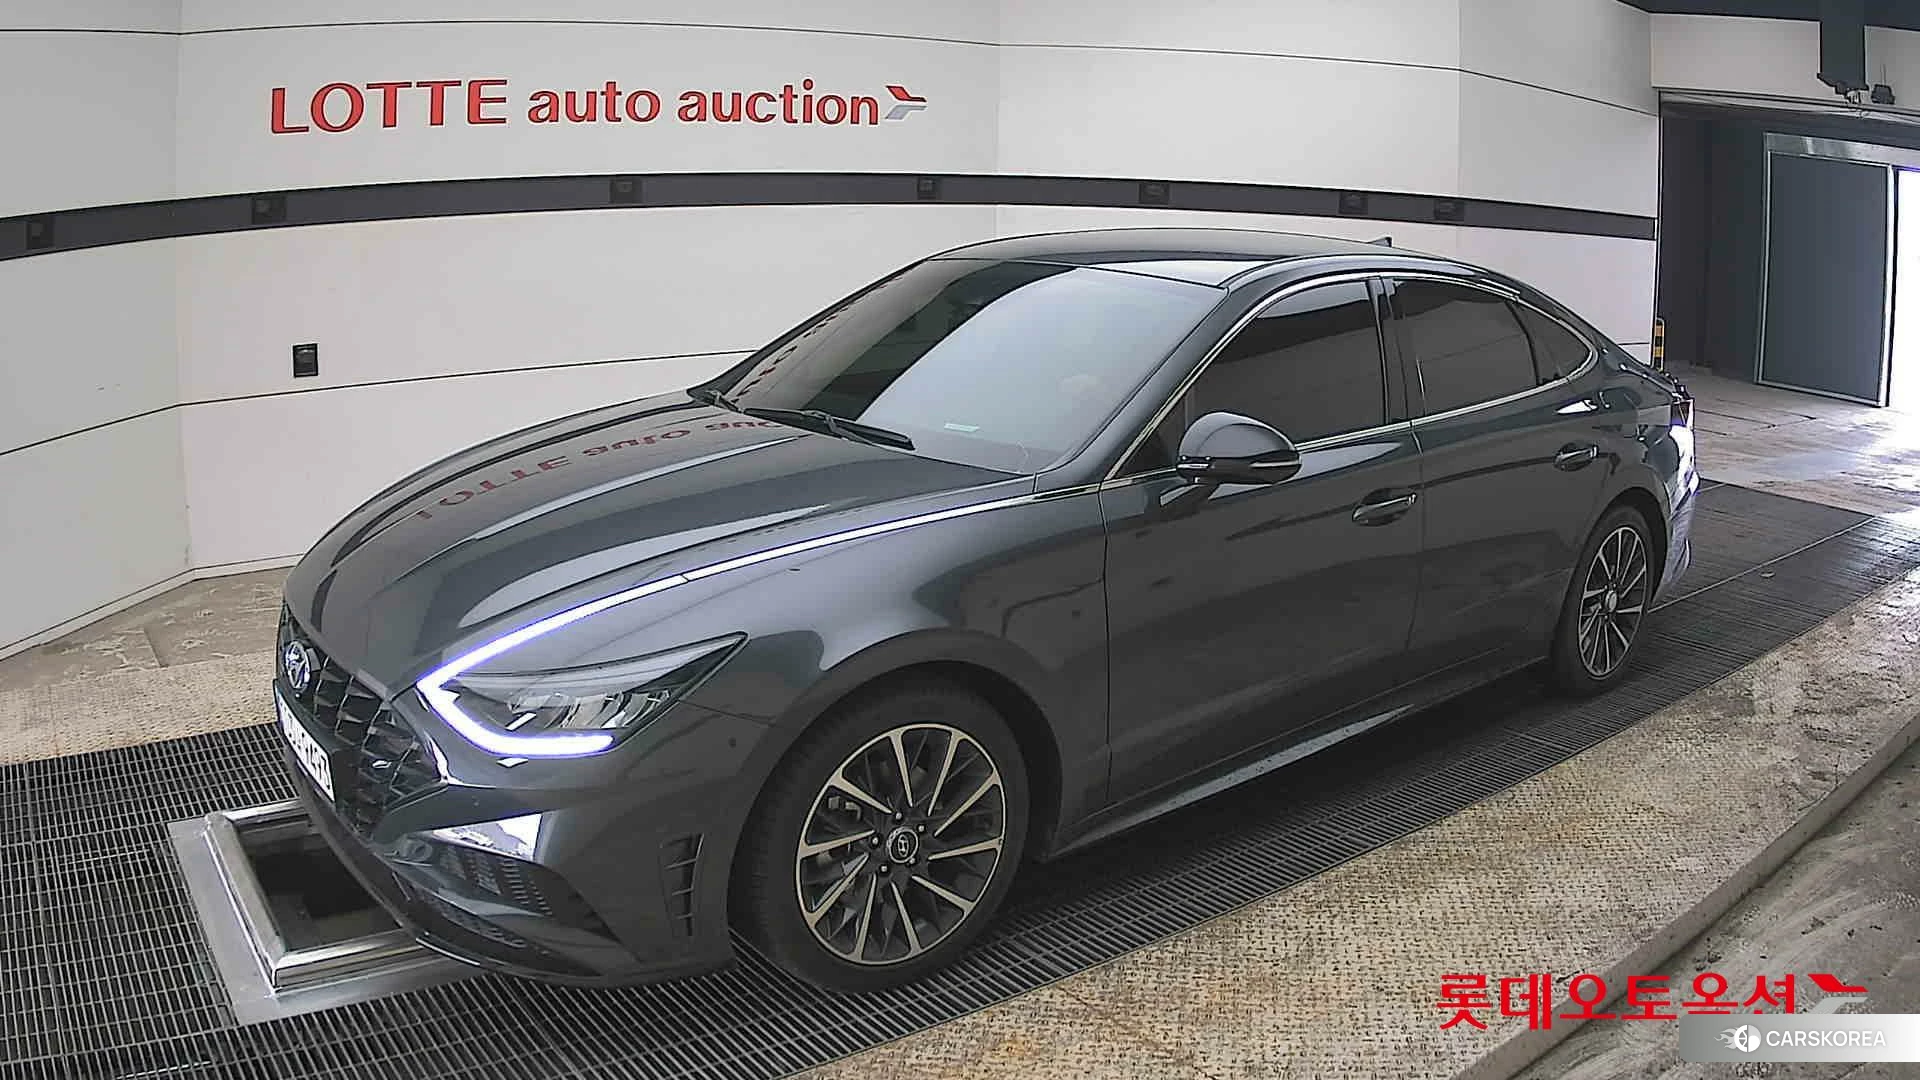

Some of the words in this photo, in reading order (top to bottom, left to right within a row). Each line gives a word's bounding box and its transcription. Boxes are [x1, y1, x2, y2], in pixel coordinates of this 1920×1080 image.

[270, 79, 507, 134] LOTTE
[527, 80, 662, 124] auto
[677, 78, 880, 125] auction
